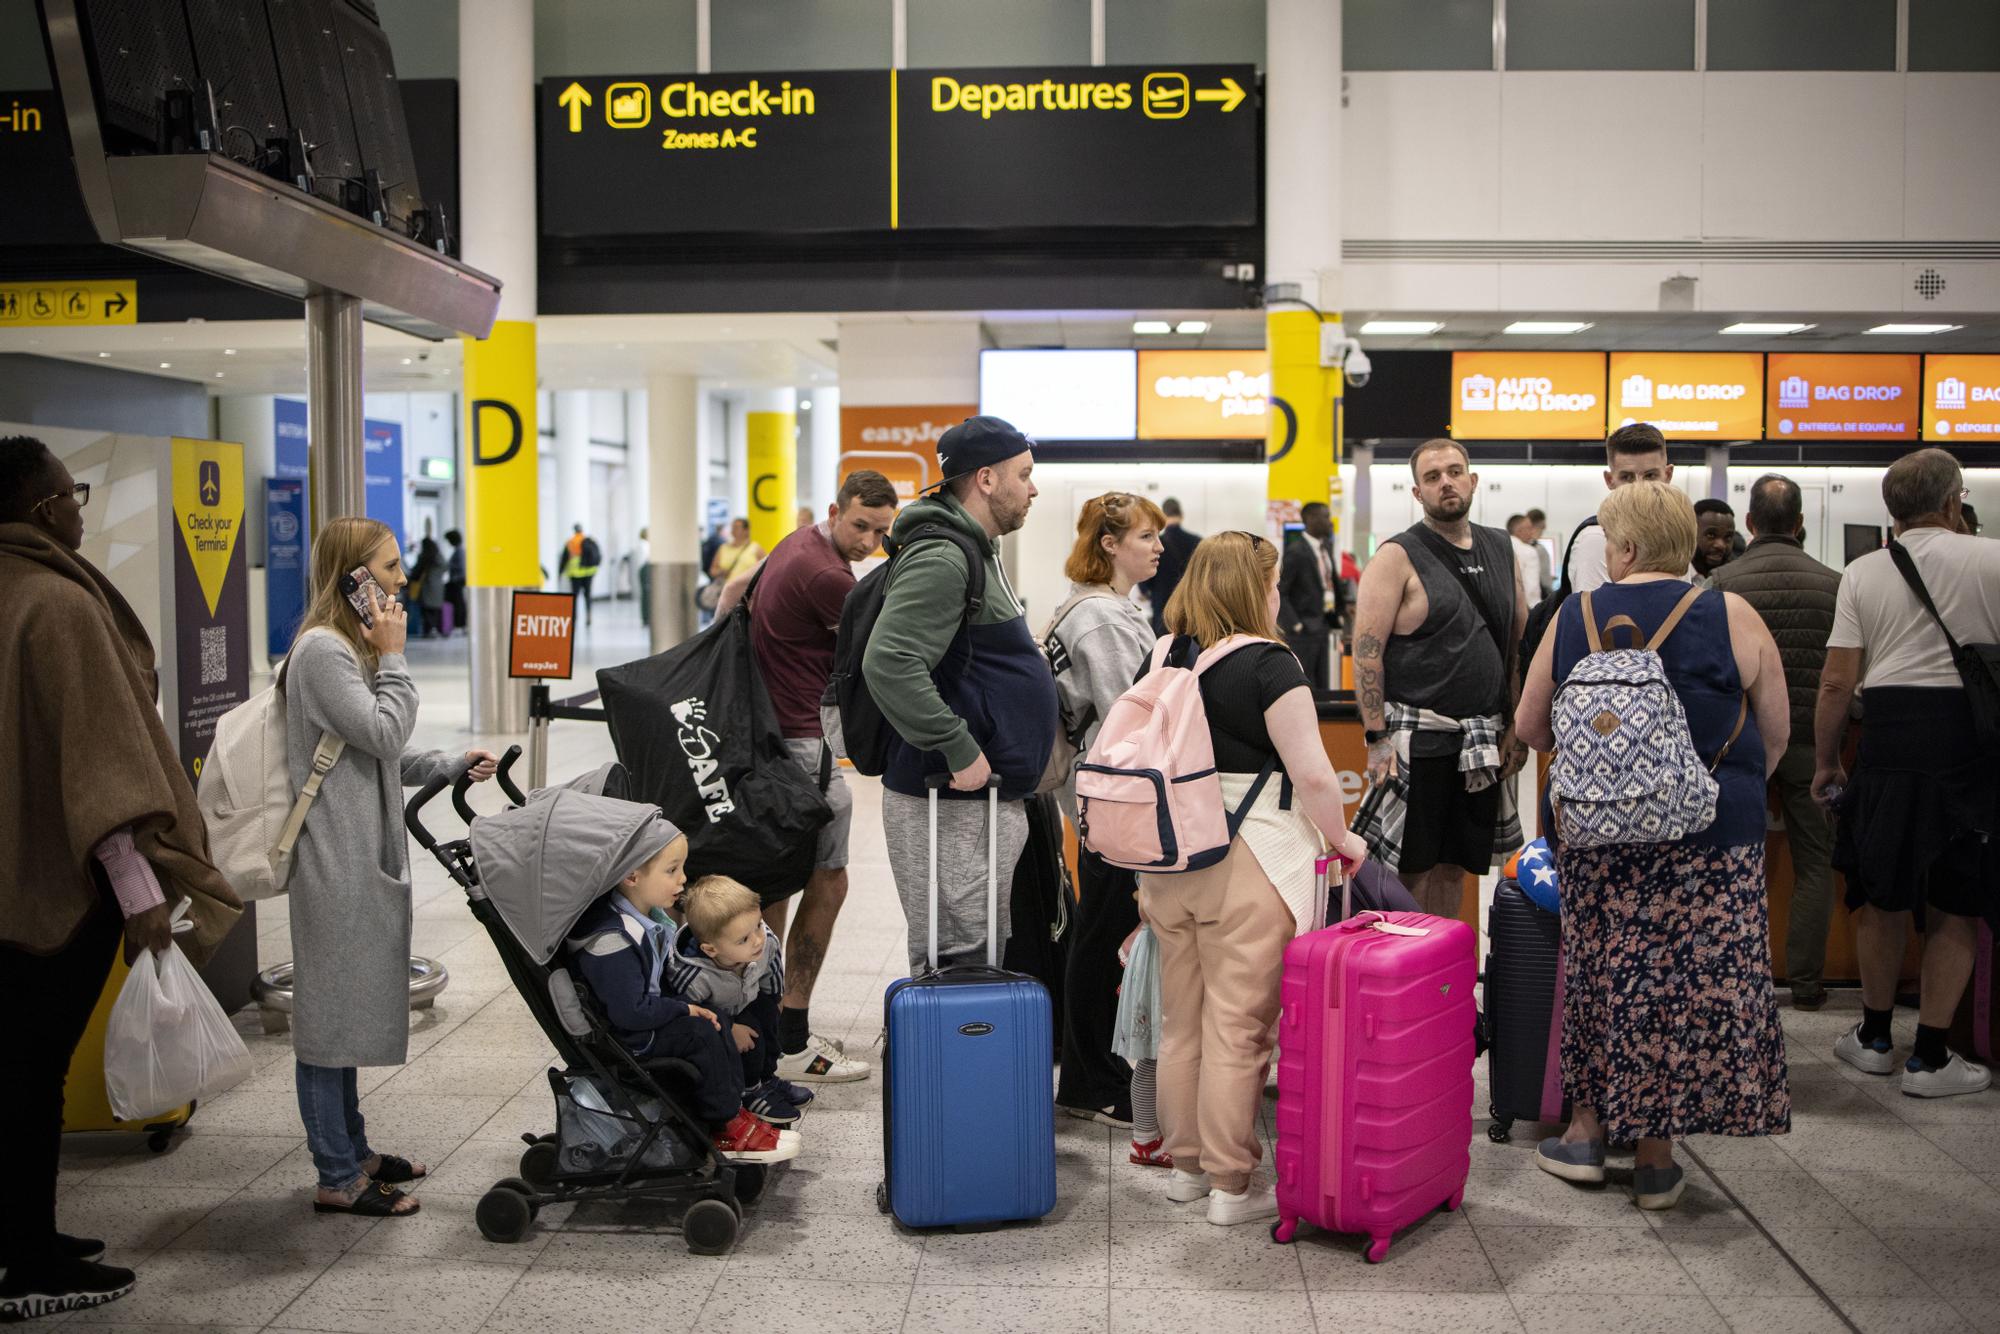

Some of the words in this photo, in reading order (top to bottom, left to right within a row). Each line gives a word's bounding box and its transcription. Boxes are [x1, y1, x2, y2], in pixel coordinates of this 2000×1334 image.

[660, 80, 815, 118] Check-in
[930, 76, 1133, 120] Departures
[661, 128, 718, 150] Zones
[719, 126, 757, 148] A-C
[1496, 377, 1552, 395] AUTO
[1656, 383, 1695, 400] BAG
[1695, 383, 1745, 400] DROP
[1814, 385, 1851, 401] BAG
[1853, 385, 1902, 401] DROP
[1222, 397, 1266, 418] plus
[1496, 394, 1539, 411] BAG
[1540, 394, 1597, 411] DROP
[472, 400, 523, 466] D
[862, 422, 951, 446] easyJe
[1797, 422, 1842, 433] ENTREGA
[1843, 422, 1858, 433] DE
[1858, 422, 1905, 433] EQUIPAJE
[1954, 421, 1993, 433] DÉPOSE
[752, 473, 778, 512] C
[187, 512, 214, 530] Check
[214, 518, 233, 535] your
[193, 535, 229, 552] Terminal
[516, 614, 571, 638] ENTRY
[523, 661, 558, 672] easyJet
